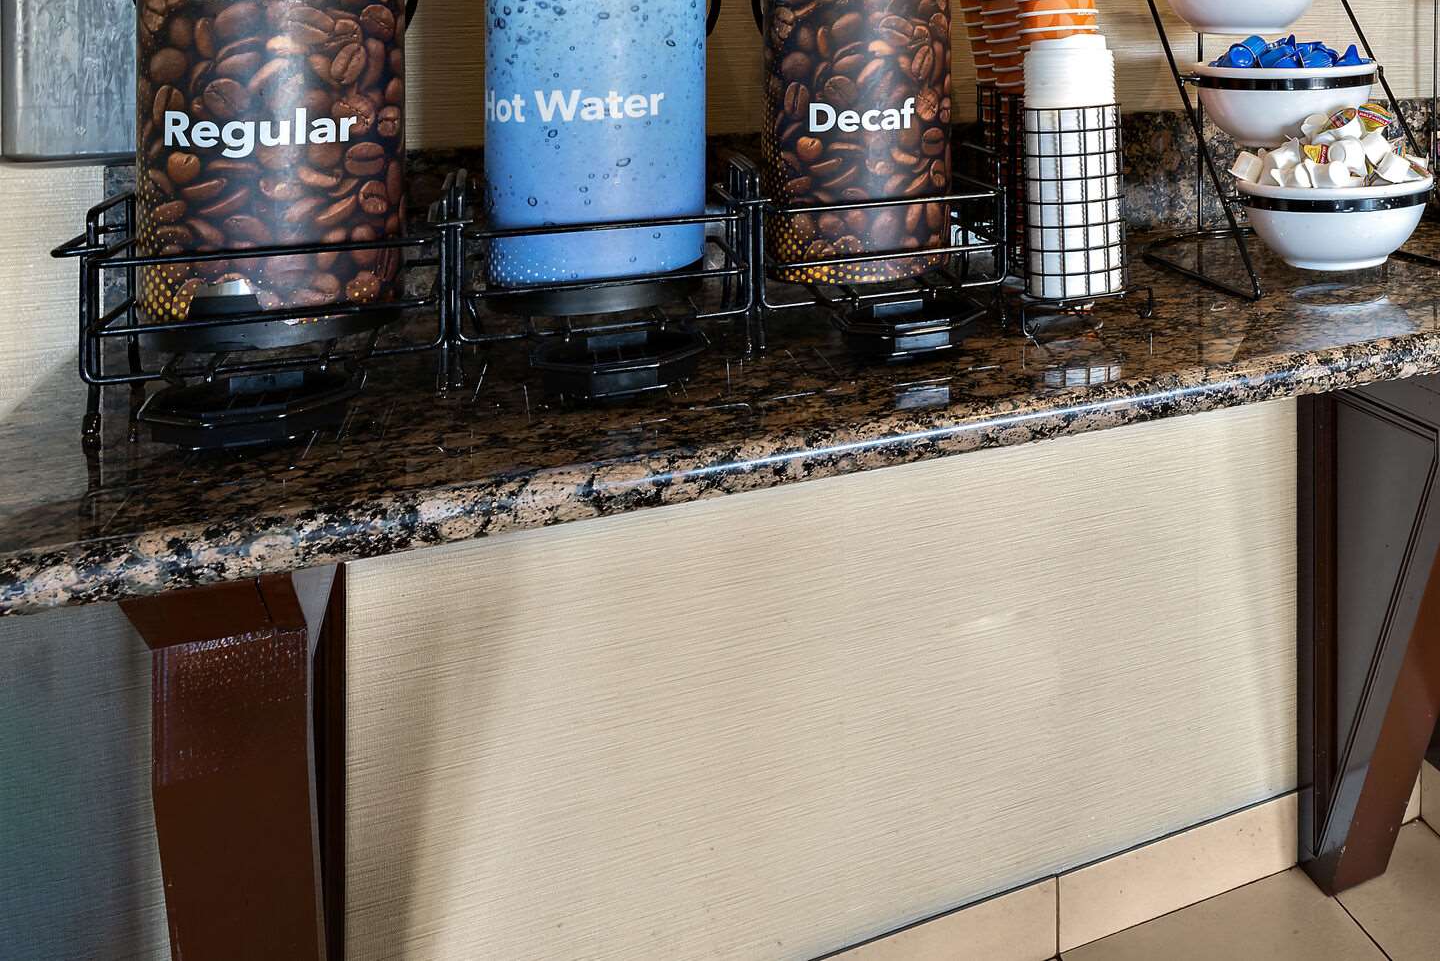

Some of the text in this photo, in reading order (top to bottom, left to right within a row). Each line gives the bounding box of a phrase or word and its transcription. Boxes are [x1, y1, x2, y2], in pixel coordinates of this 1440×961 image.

[484, 89, 665, 123] Hot Water
[809, 97, 915, 132] Decaf
[164, 107, 357, 159] Regular
